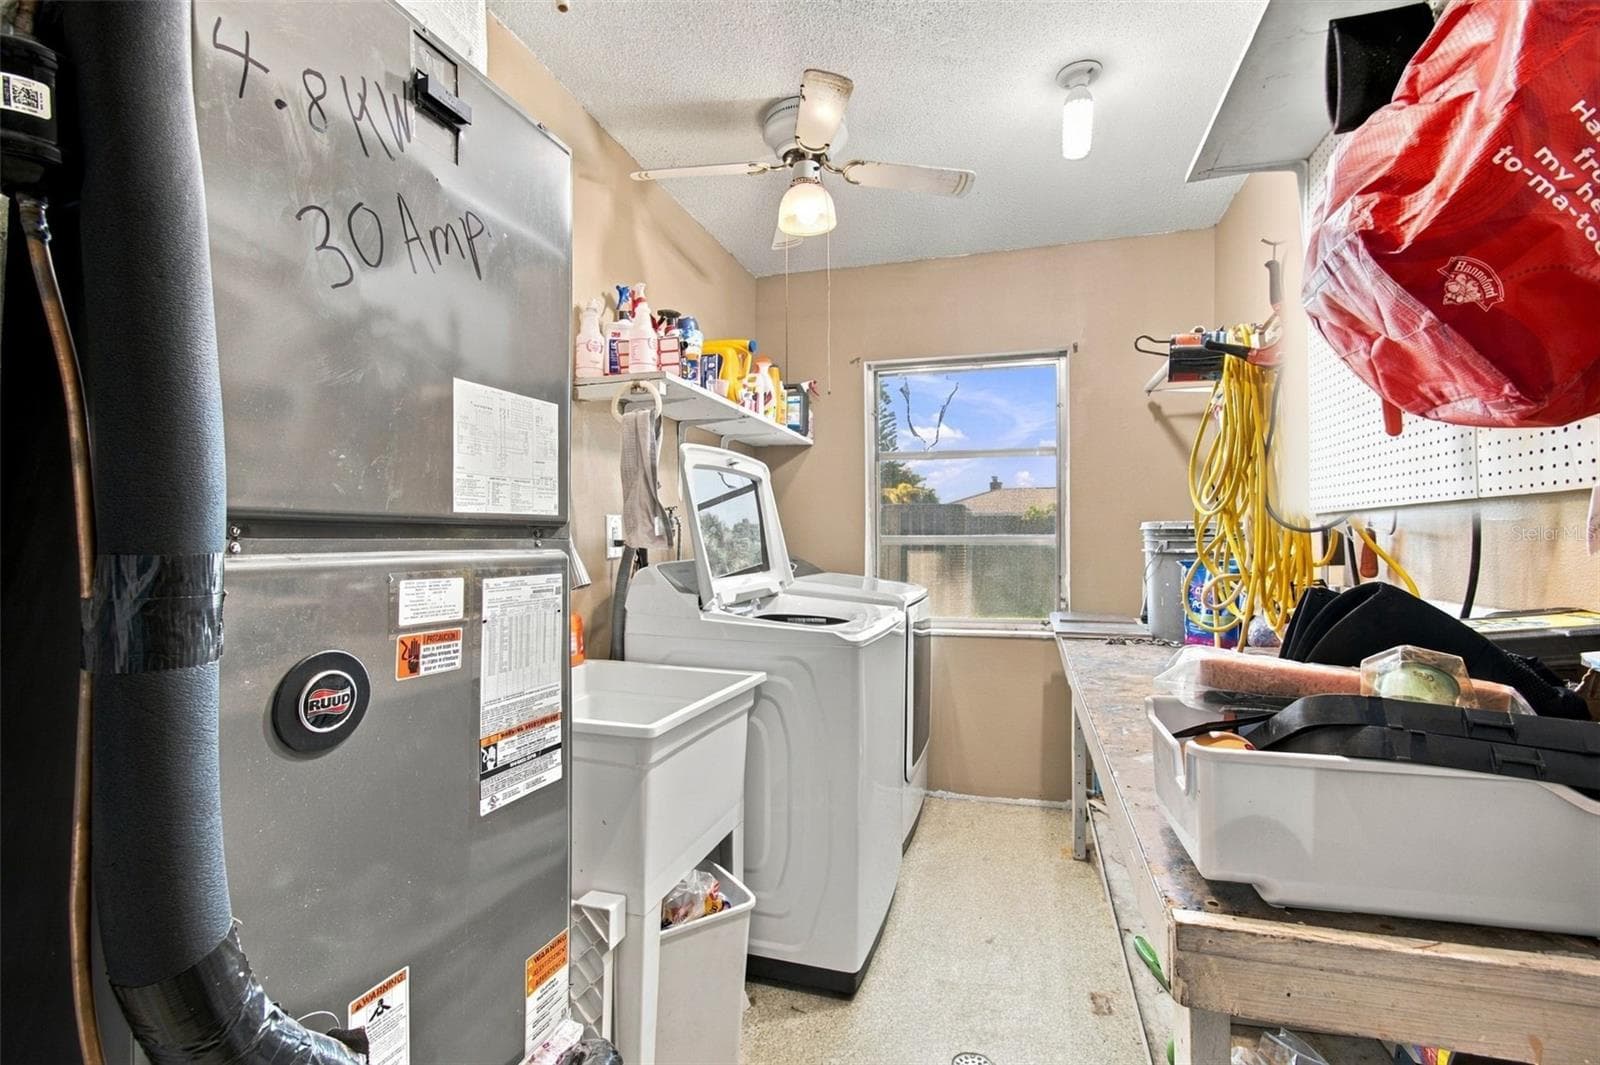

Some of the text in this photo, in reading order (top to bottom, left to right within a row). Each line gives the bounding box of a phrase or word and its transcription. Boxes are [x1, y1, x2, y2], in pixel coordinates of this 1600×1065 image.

[1534, 146, 1575, 181] my
[295, 192, 484, 289] 30 Amp
[309, 692, 351, 712] RUUD
[534, 933, 567, 963] WARNING
[361, 972, 406, 1006] WARNING
